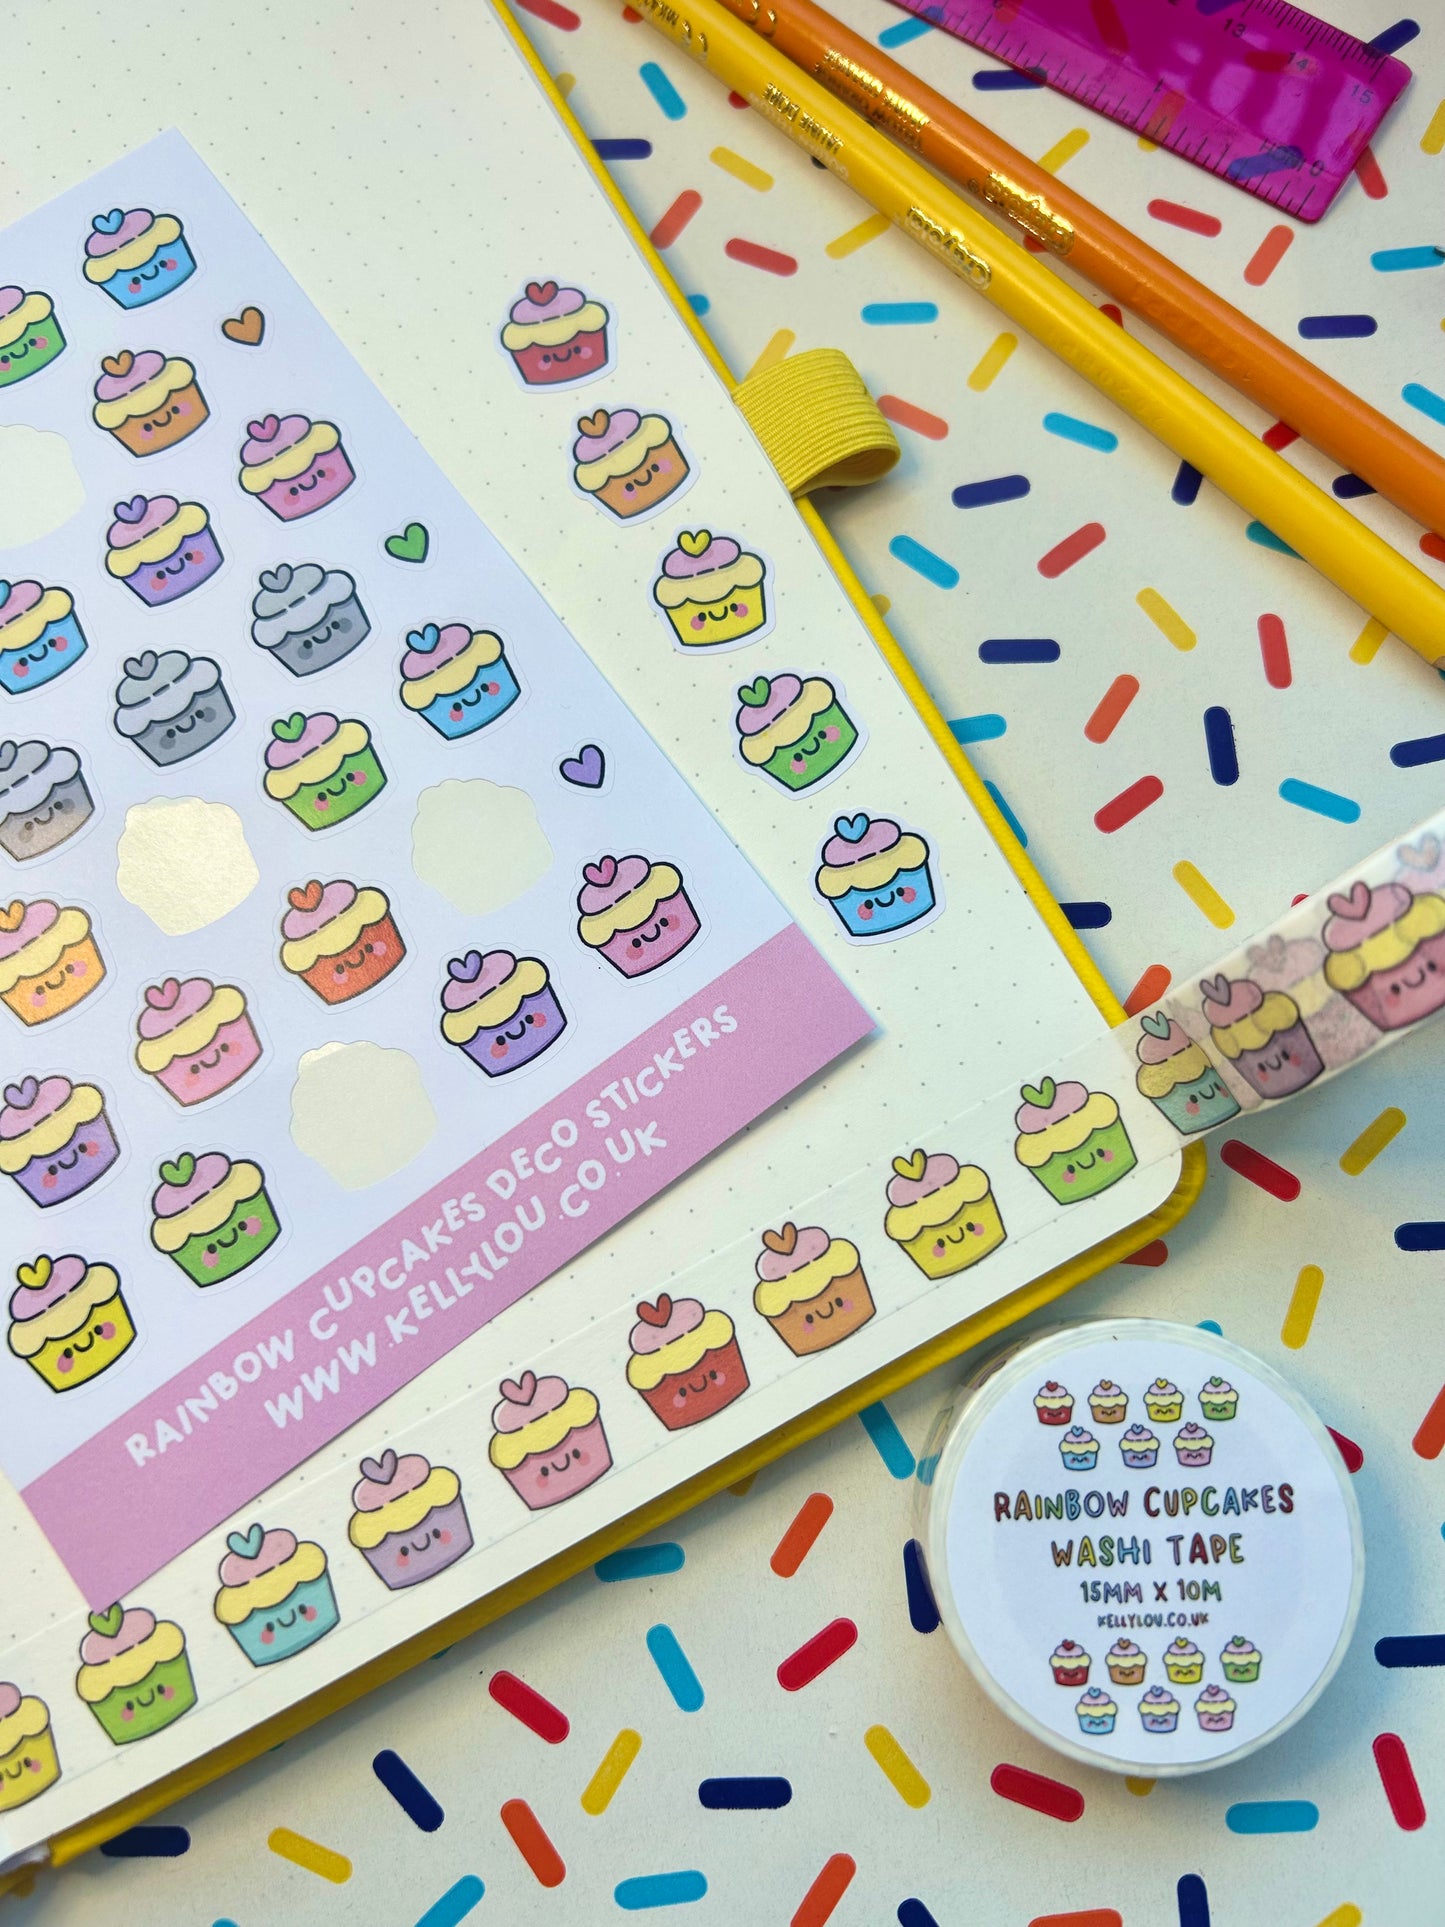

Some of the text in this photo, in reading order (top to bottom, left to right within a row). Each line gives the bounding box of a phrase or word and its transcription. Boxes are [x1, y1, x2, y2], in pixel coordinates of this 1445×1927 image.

[1222, 17, 1373, 105] 13 14 15
[1308, 159, 1326, 178] 0
[902, 202, 993, 291] Crayola
[124, 1004, 738, 1468] RAINBOW CUPCAKES DECO STICKERS
[993, 1483, 1295, 1522] RAINBOW CUPCAKES
[1050, 1532, 1245, 1567] WASHI TAPE
[1079, 1580, 1144, 1605] 15MM
[1176, 1578, 1223, 1603] 10M
[1096, 1611, 1210, 1629] KELLYLOU.CO.UK
